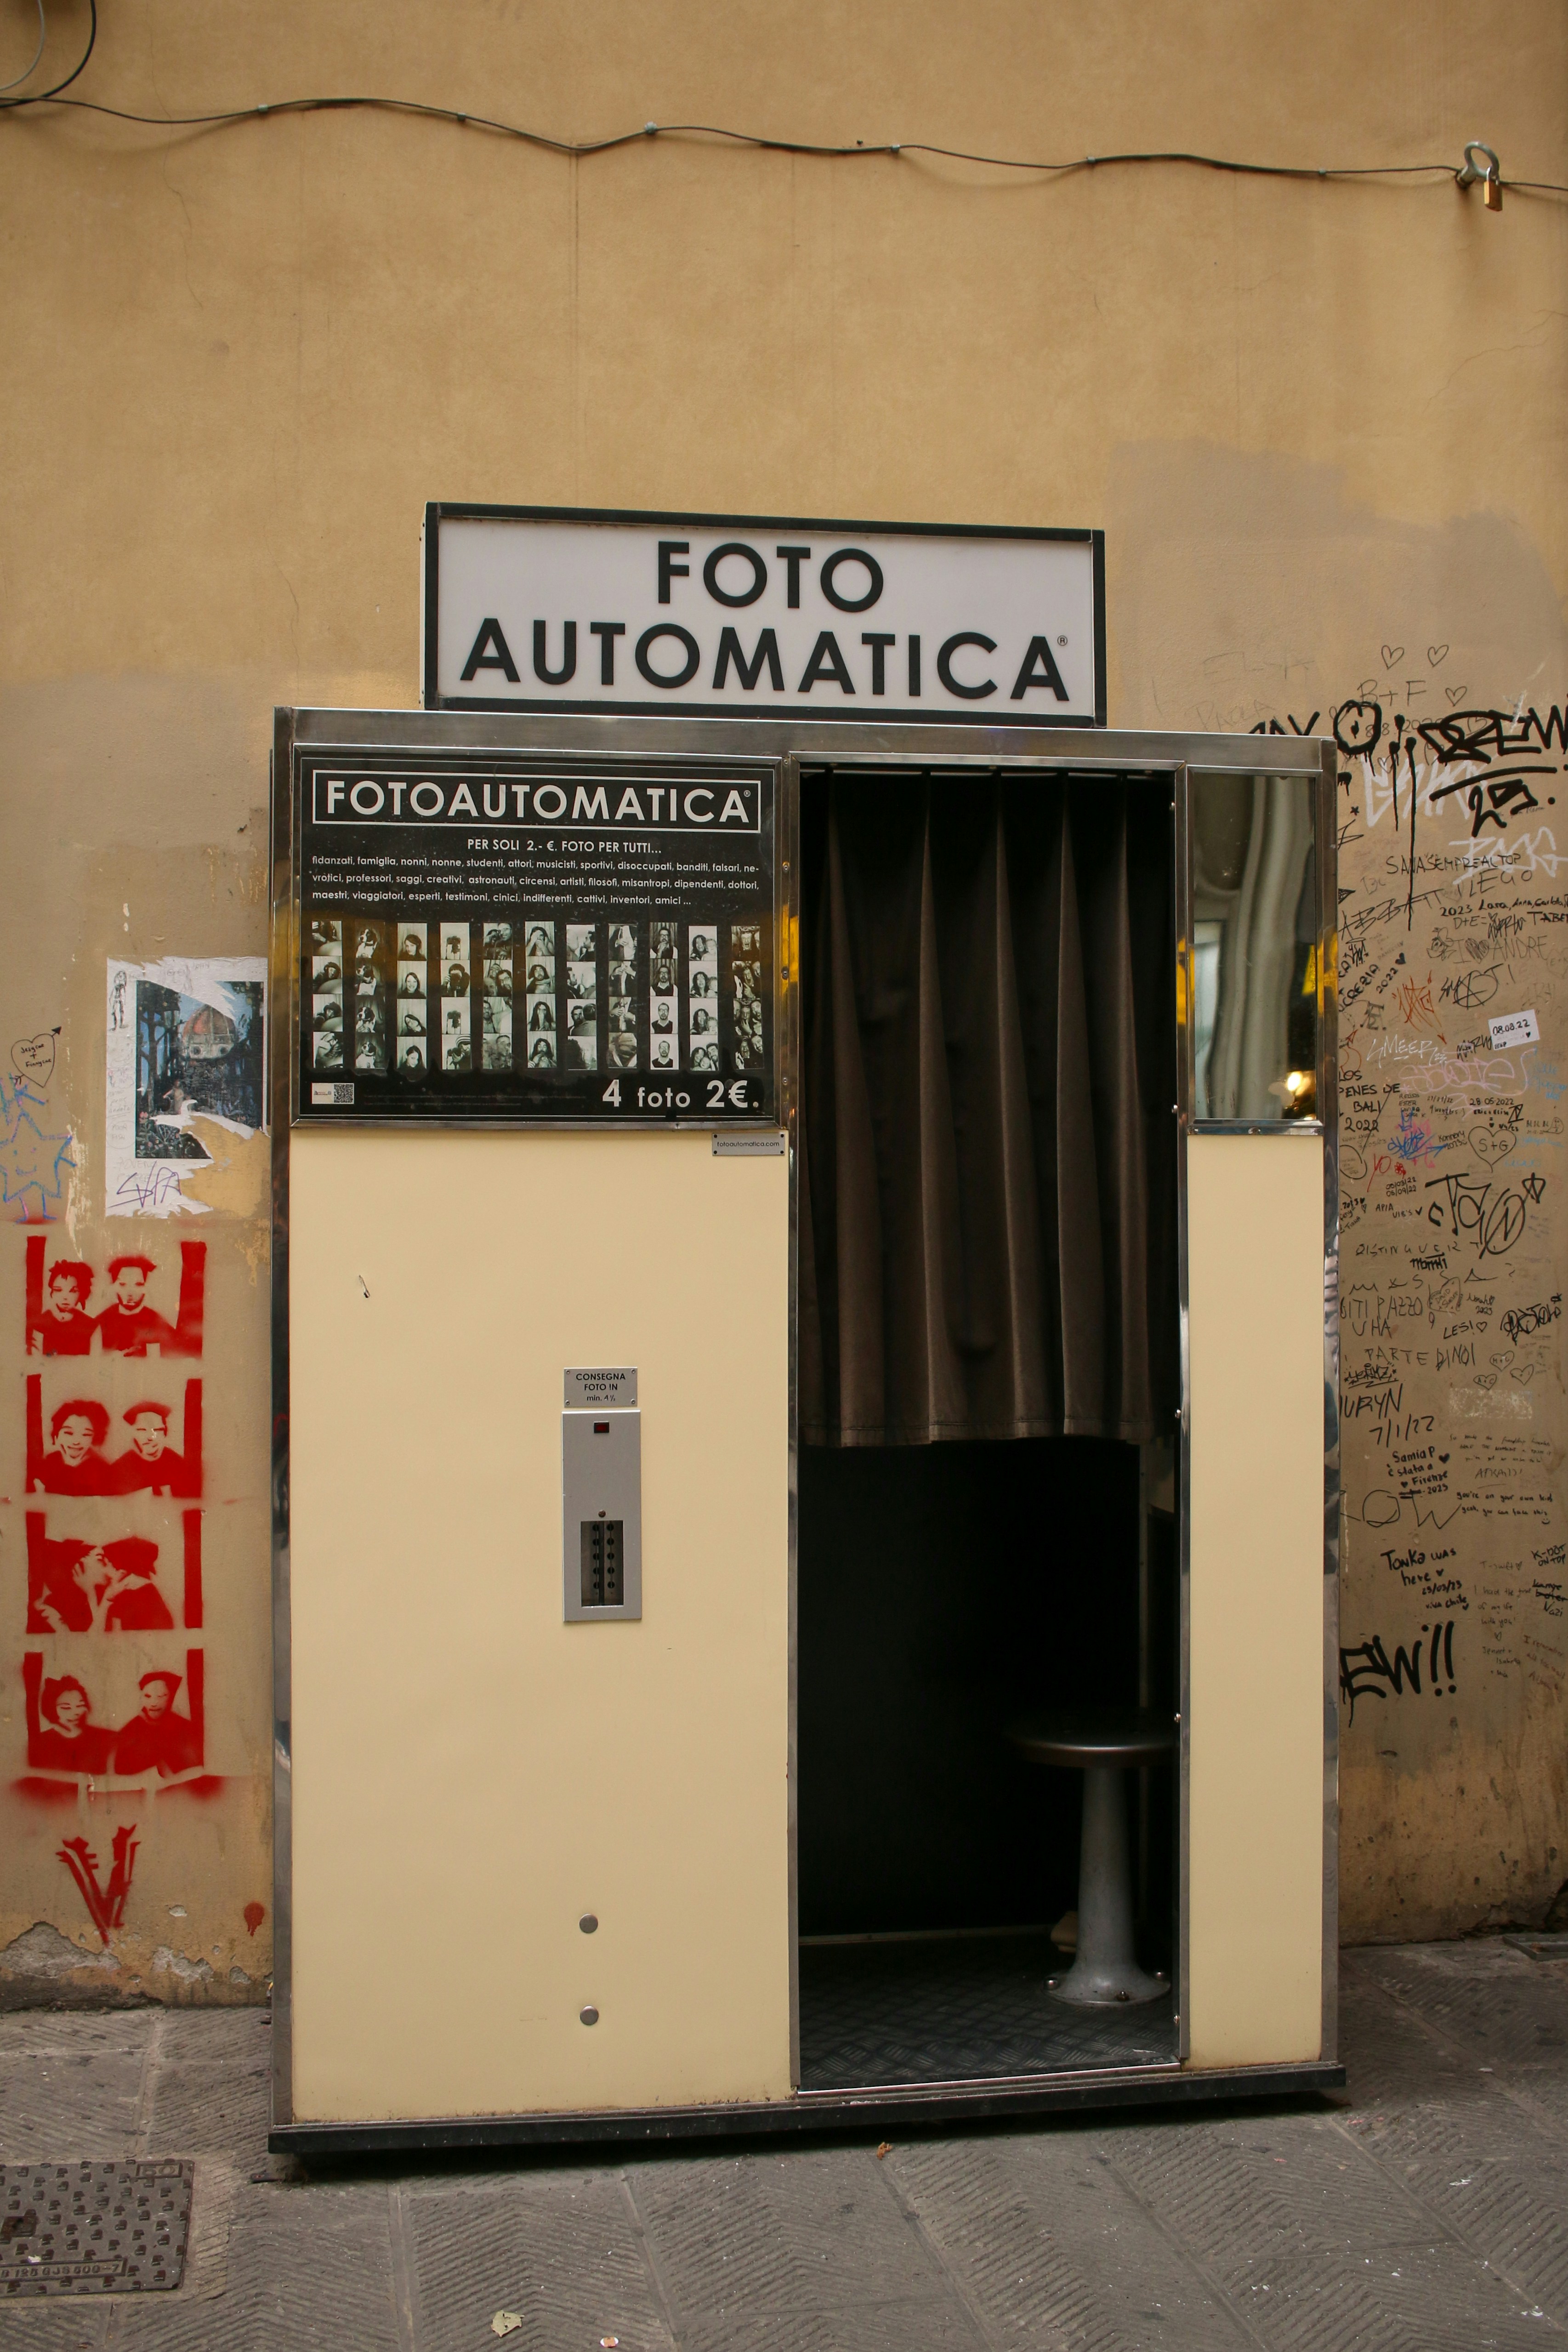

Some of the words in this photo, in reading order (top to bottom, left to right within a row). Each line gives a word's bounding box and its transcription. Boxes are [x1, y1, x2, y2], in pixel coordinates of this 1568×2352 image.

[657, 540, 884, 614] FOTO
[468, 839, 489, 849] PER
[493, 839, 519, 850] SOLI
[562, 841, 594, 852] FOTO
[599, 842, 619, 853] PER
[623, 842, 661, 854] TUTTI...
[312, 855, 355, 866] fidanzati,
[357, 856, 398, 867] famiglia,
[401, 857, 429, 867] nonni,
[432, 859, 464, 868] nonne,
[466, 858, 506, 868] studenti,
[508, 859, 534, 869] attori,
[536, 860, 578, 870] musicisti,
[580, 860, 615, 871] sportivi,
[617, 861, 674, 872] disoccupati,
[676, 862, 710, 872] banditi,
[712, 863, 742, 873] falsari,
[312, 873, 344, 883] vrotici,
[346, 874, 394, 884] professori,
[396, 875, 424, 885] saggi,
[426, 875, 464, 884] creativi,
[468, 875, 517, 885] astronauti,
[519, 876, 557, 886] circensi,
[560, 877, 586, 887] artisti,
[588, 877, 619, 888] filosofi,
[622, 878, 672, 889] misantropi,
[674, 879, 726, 890] dipendenti,
[728, 880, 759, 890] dottori,
[312, 890, 350, 900] maestri,
[352, 891, 405, 901] viaggiatori,
[409, 892, 443, 902] esperti,
[445, 892, 490, 902] testimoni,
[493, 893, 520, 903] cinici,
[523, 893, 574, 904] indifferenti,
[577, 894, 608, 904] cattivi,
[610, 895, 652, 905] inventori,
[655, 896, 681, 905] amici
[1439, 904, 1473, 917] 2023
[602, 1079, 622, 1107] 4
[637, 1086, 691, 1108] foto
[1392, 1449, 1426, 1463] Samia
[1397, 1464, 1424, 1477] stata
[1411, 1470, 1448, 1486] Firenze
[1400, 1569, 1432, 1586] here
